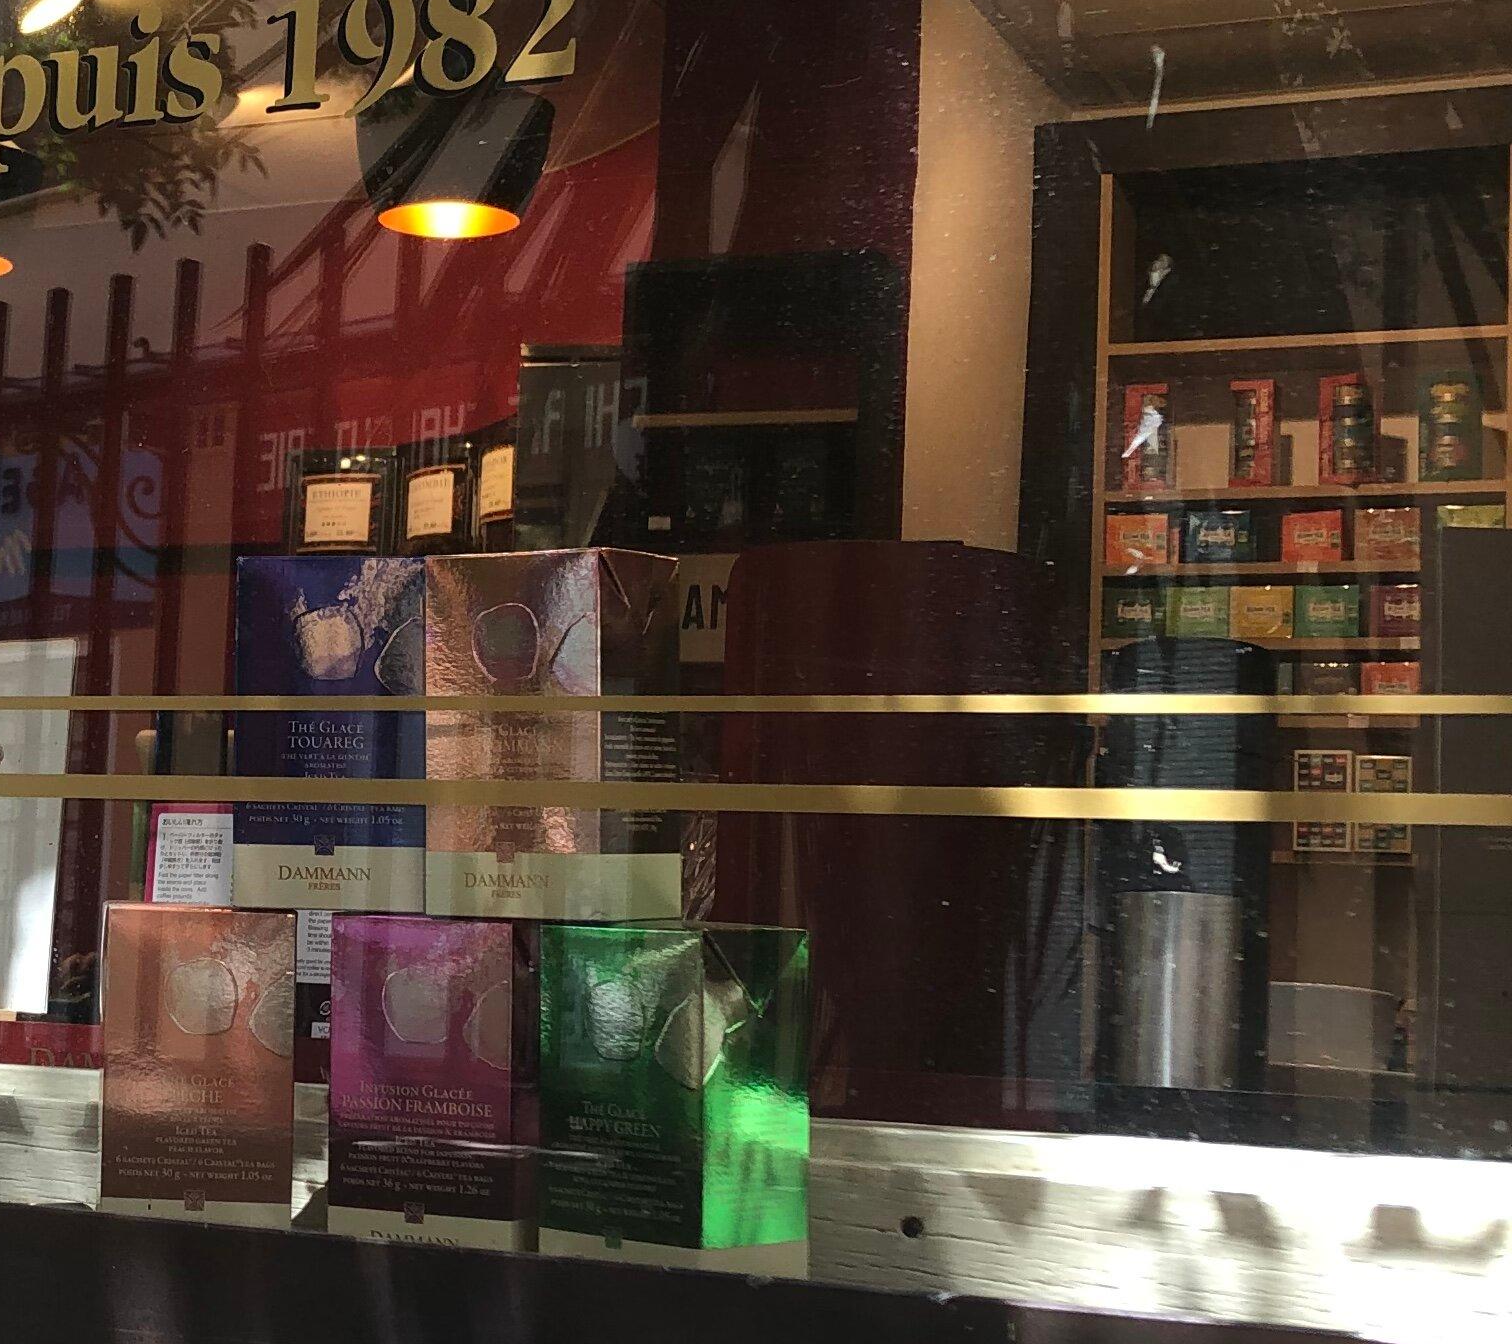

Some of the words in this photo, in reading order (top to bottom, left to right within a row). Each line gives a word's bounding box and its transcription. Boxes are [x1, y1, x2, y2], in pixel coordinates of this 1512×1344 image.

[288, 735, 365, 749] TOUAREG
[278, 865, 371, 881] DAMMANN
[464, 871, 550, 889] DAMMANN
[360, 1080, 419, 1096] INFUSION
[342, 1094, 402, 1112] PASSION
[405, 1099, 494, 1118] FRAMBOISE
[613, 1121, 662, 1138] GREEN
